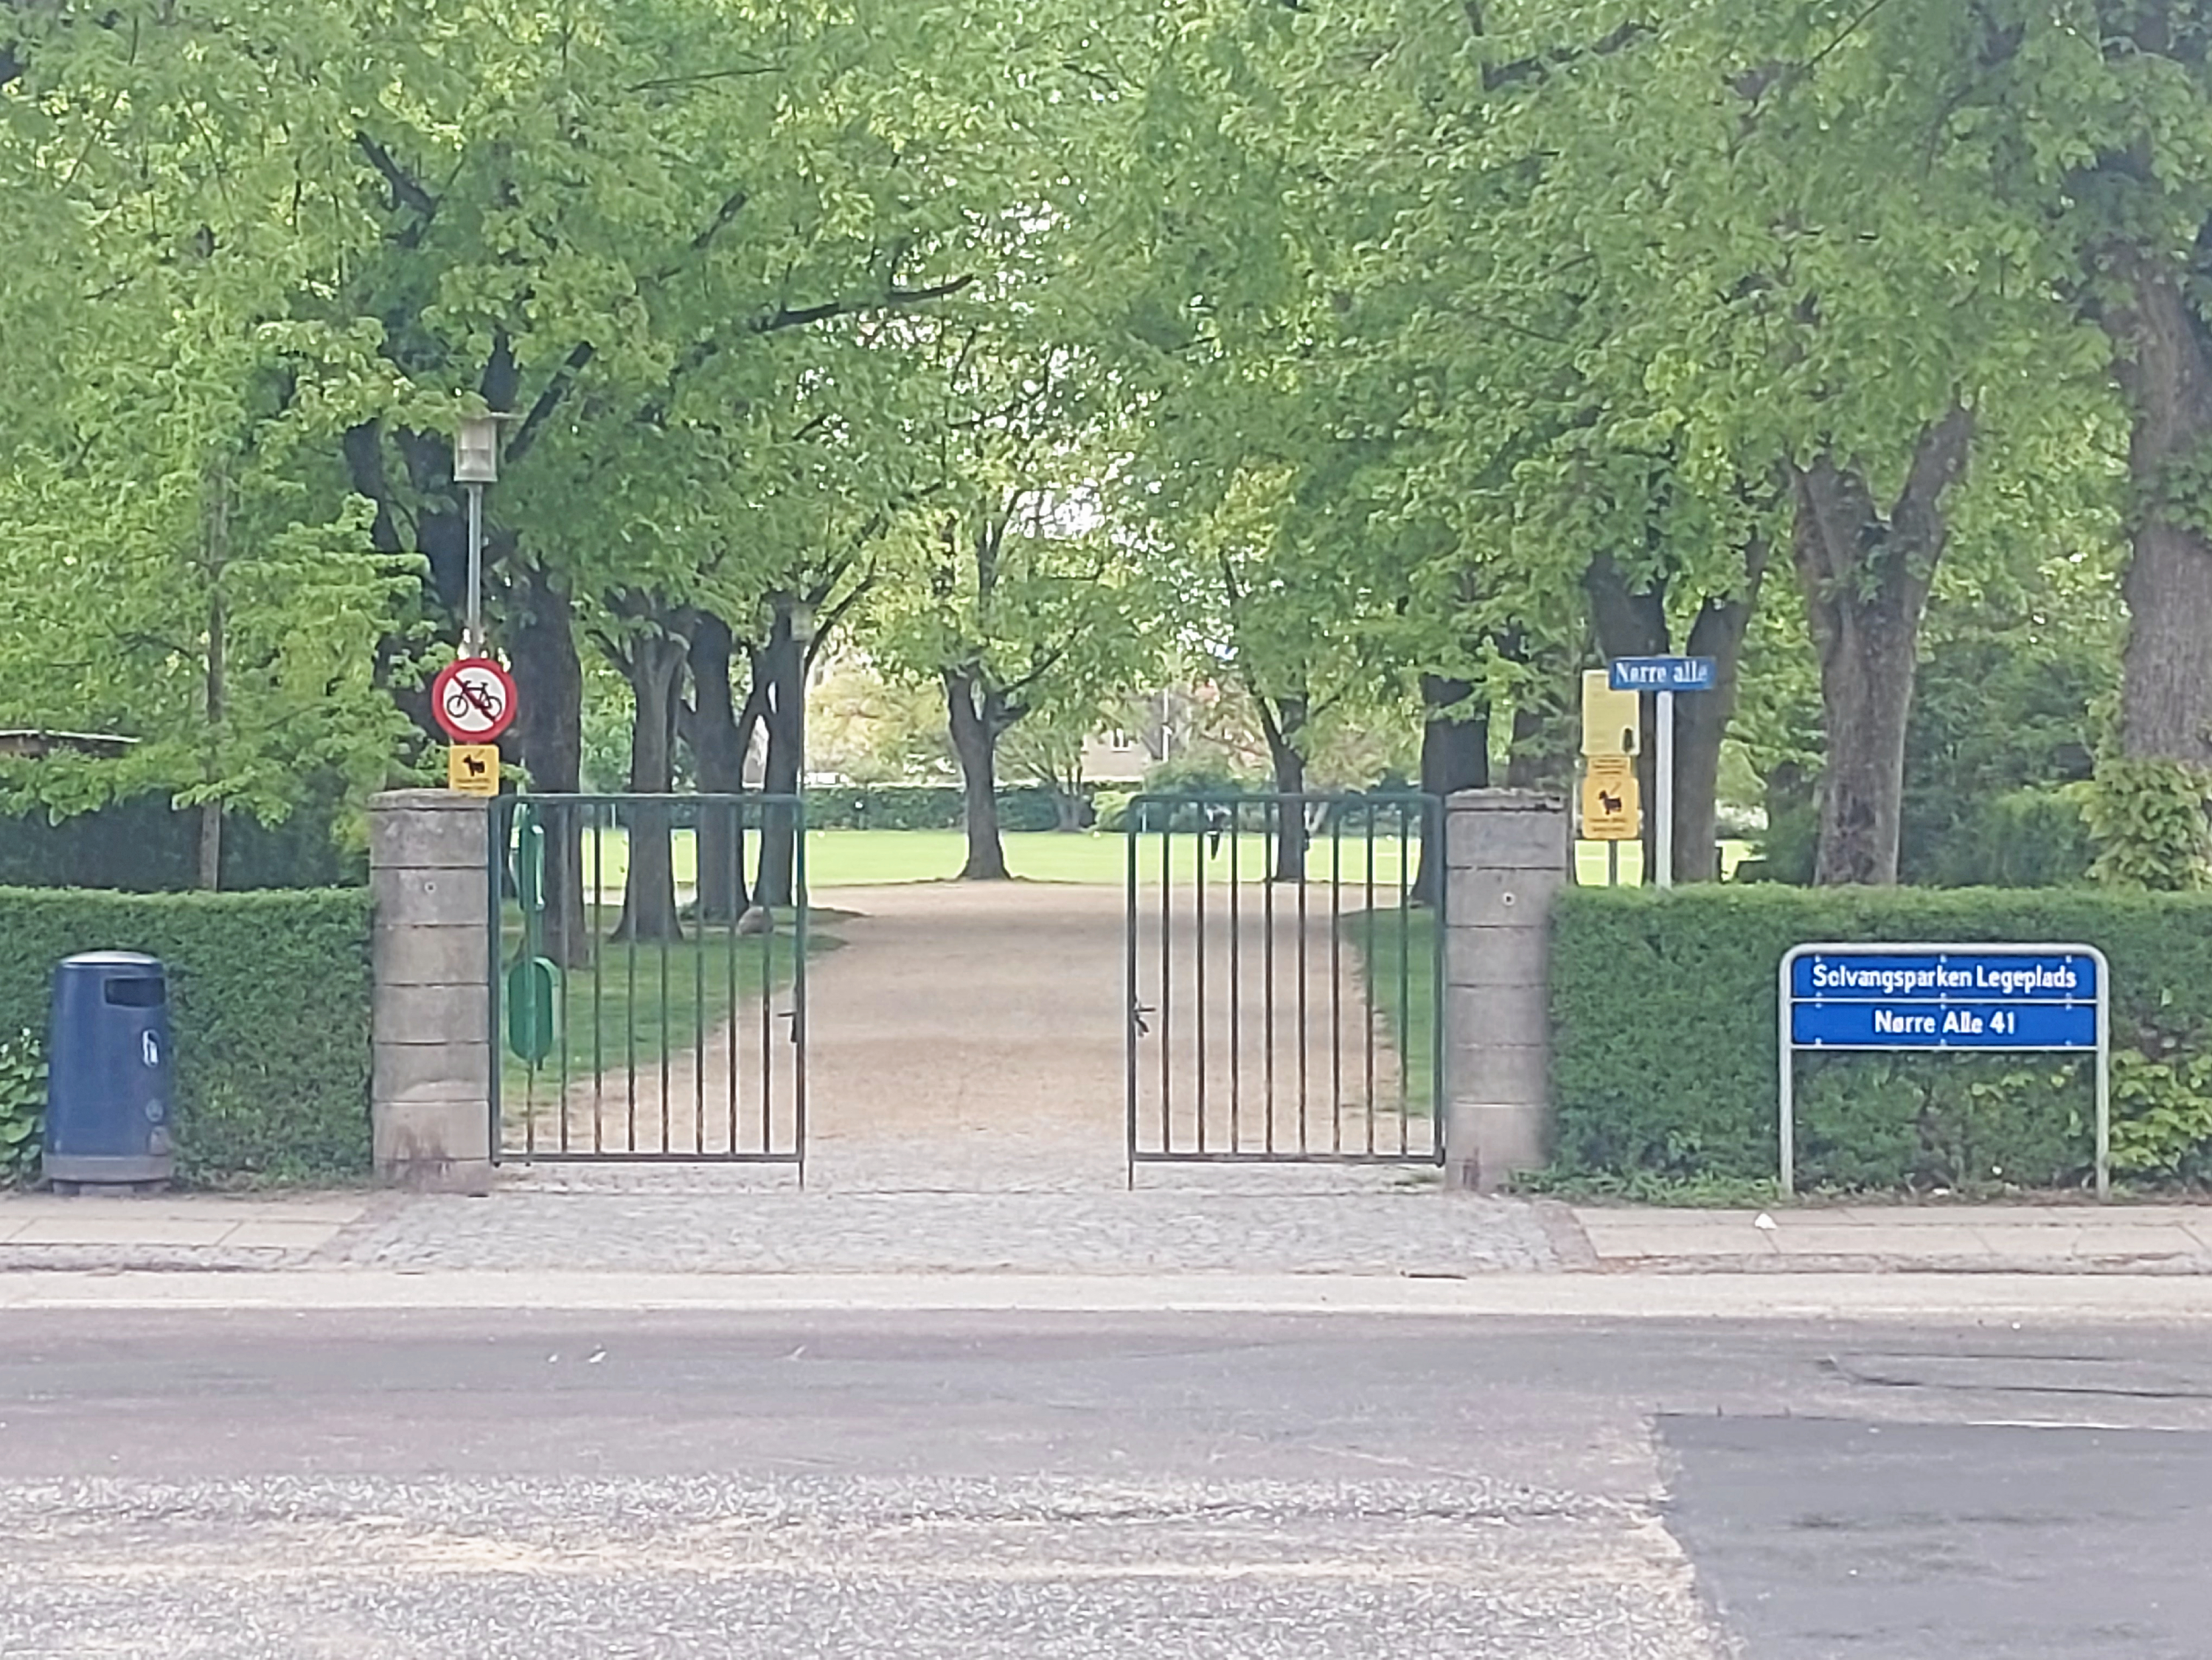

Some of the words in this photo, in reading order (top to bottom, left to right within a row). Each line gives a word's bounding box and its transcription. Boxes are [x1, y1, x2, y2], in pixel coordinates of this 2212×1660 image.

[1812, 963, 1972, 994] Solvangsparken
[1976, 964, 2077, 994] Legeplads
[1874, 1010, 1935, 1033] Nørre
[1942, 1010, 1983, 1034] Alle
[1989, 1010, 2015, 1035] 41
